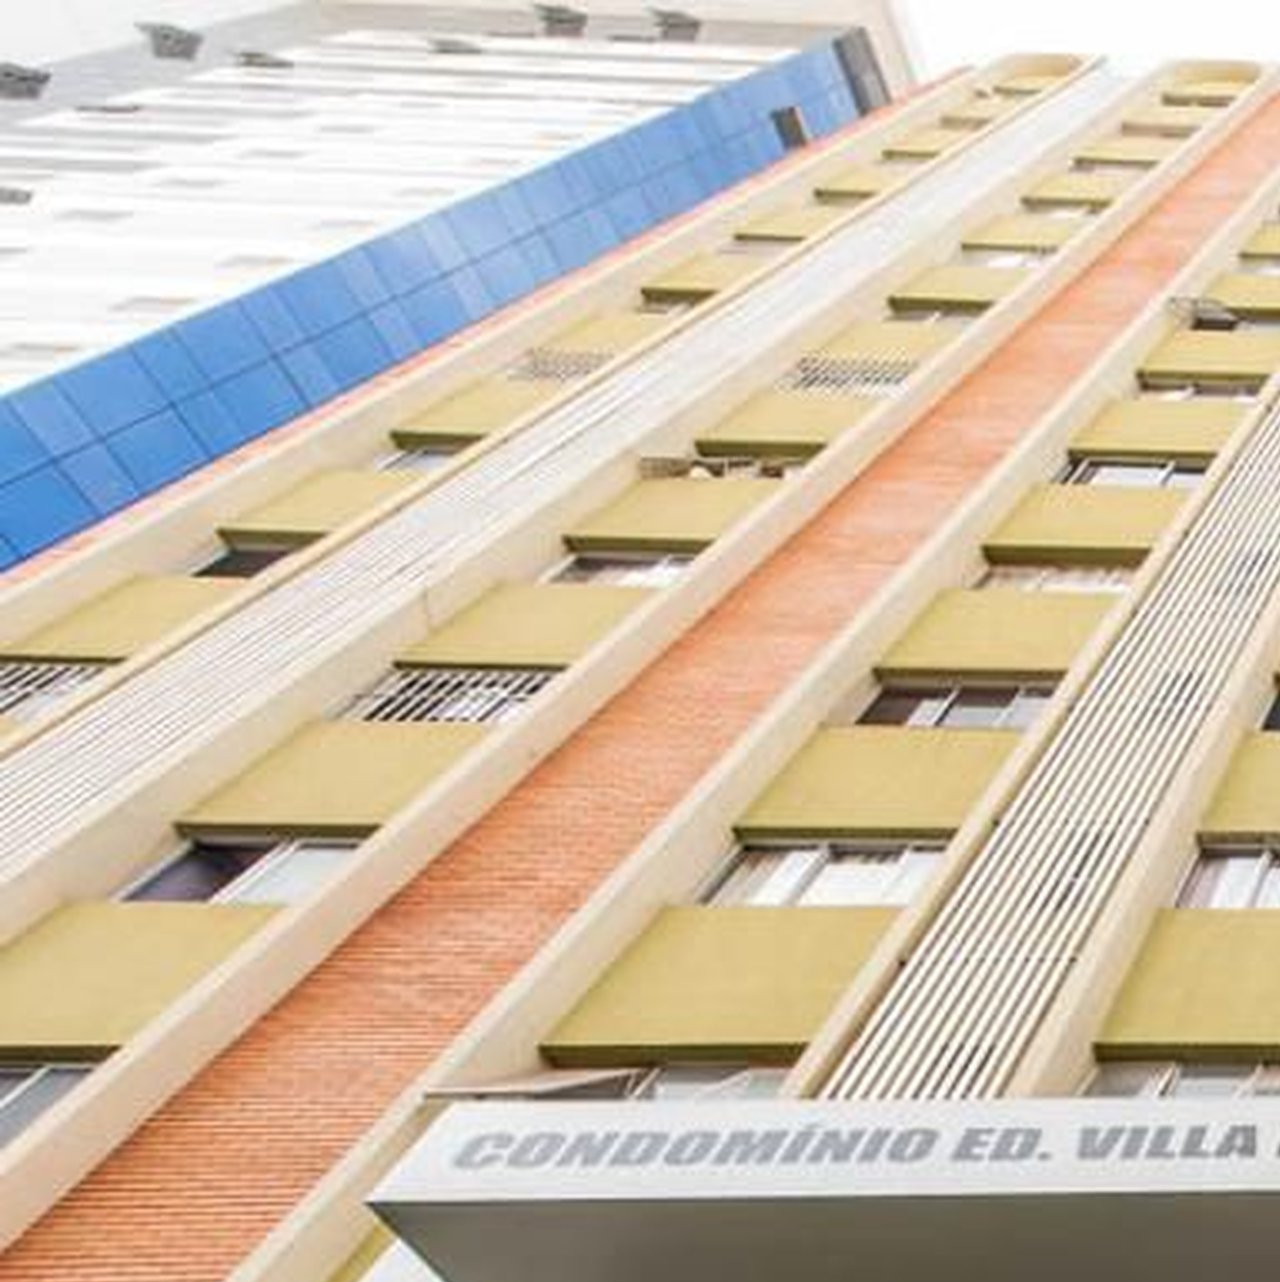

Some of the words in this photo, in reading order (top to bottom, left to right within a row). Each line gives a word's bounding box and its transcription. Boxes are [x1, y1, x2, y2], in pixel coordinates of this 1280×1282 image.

[453, 1123, 938, 1170] CONDOMÍNIO
[951, 1126, 1053, 1163] ED.
[1077, 1125, 1259, 1161] VILLA
